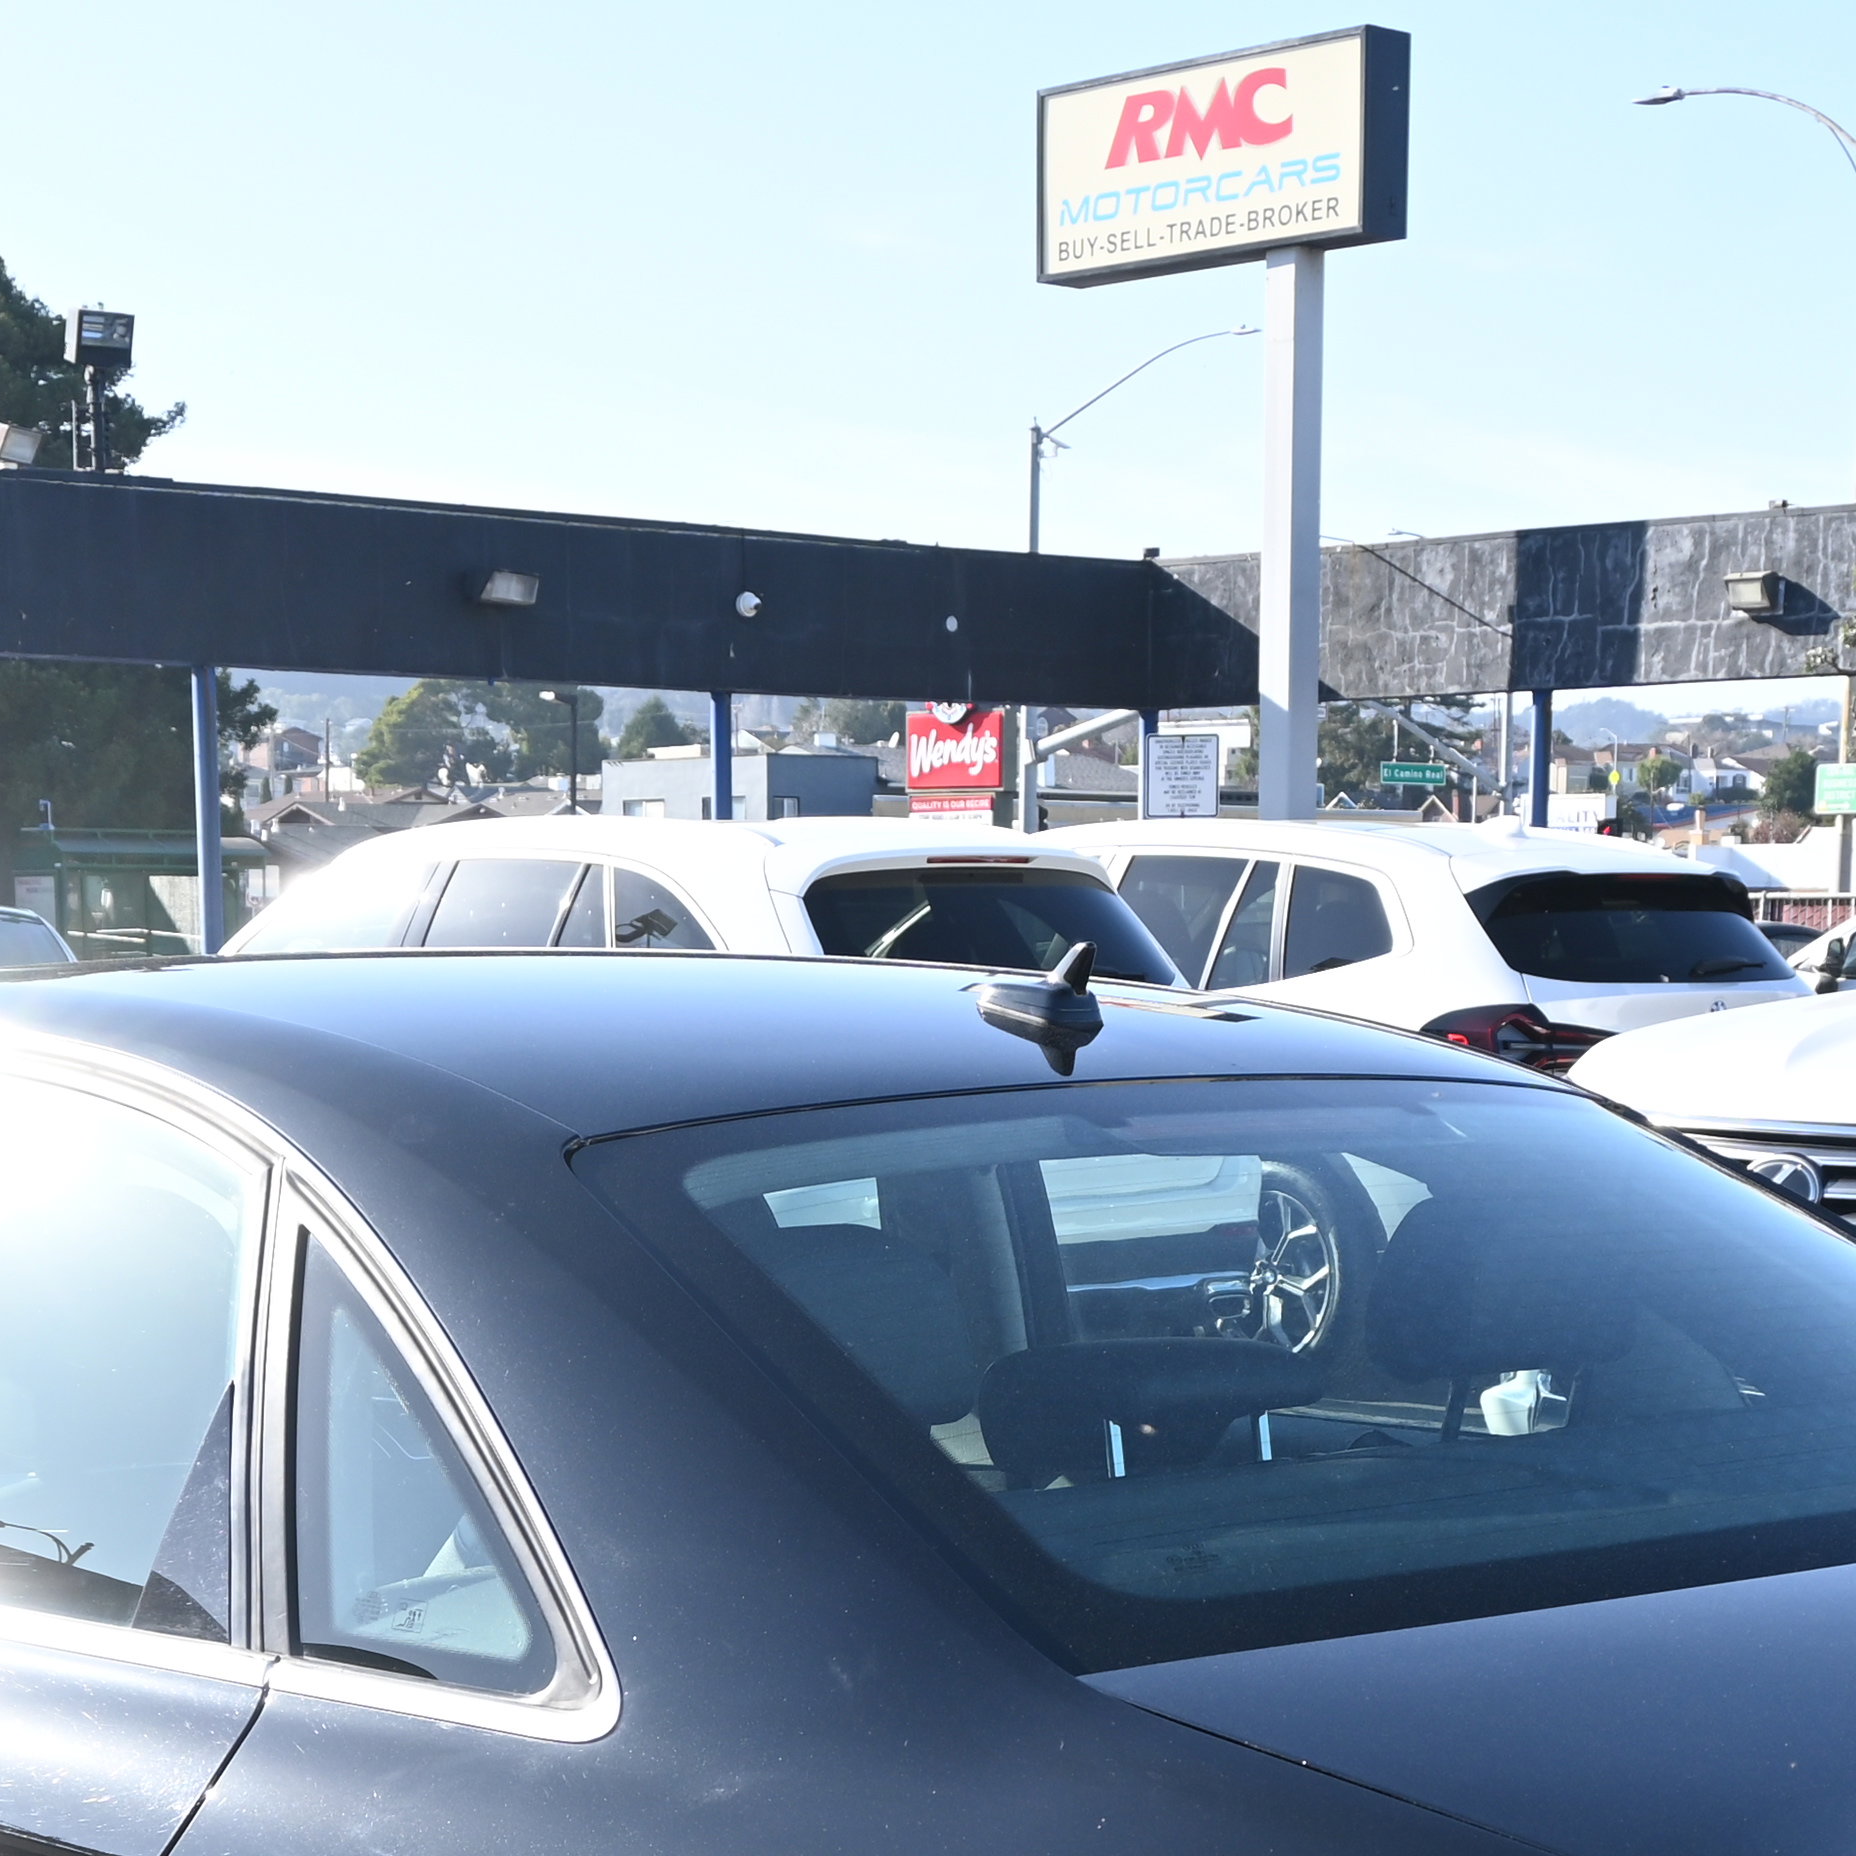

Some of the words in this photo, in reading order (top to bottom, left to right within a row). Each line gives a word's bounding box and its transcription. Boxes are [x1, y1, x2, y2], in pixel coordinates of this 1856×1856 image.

[1104, 67, 1293, 170] RMC
[1058, 152, 1341, 226] MOTORCARS
[1058, 197, 1340, 262] BUY-SELL-TRADE-BROKER
[910, 722, 998, 778] Wendy's
[1394, 769, 1423, 778] Camino
[1425, 769, 1443, 779] Real
